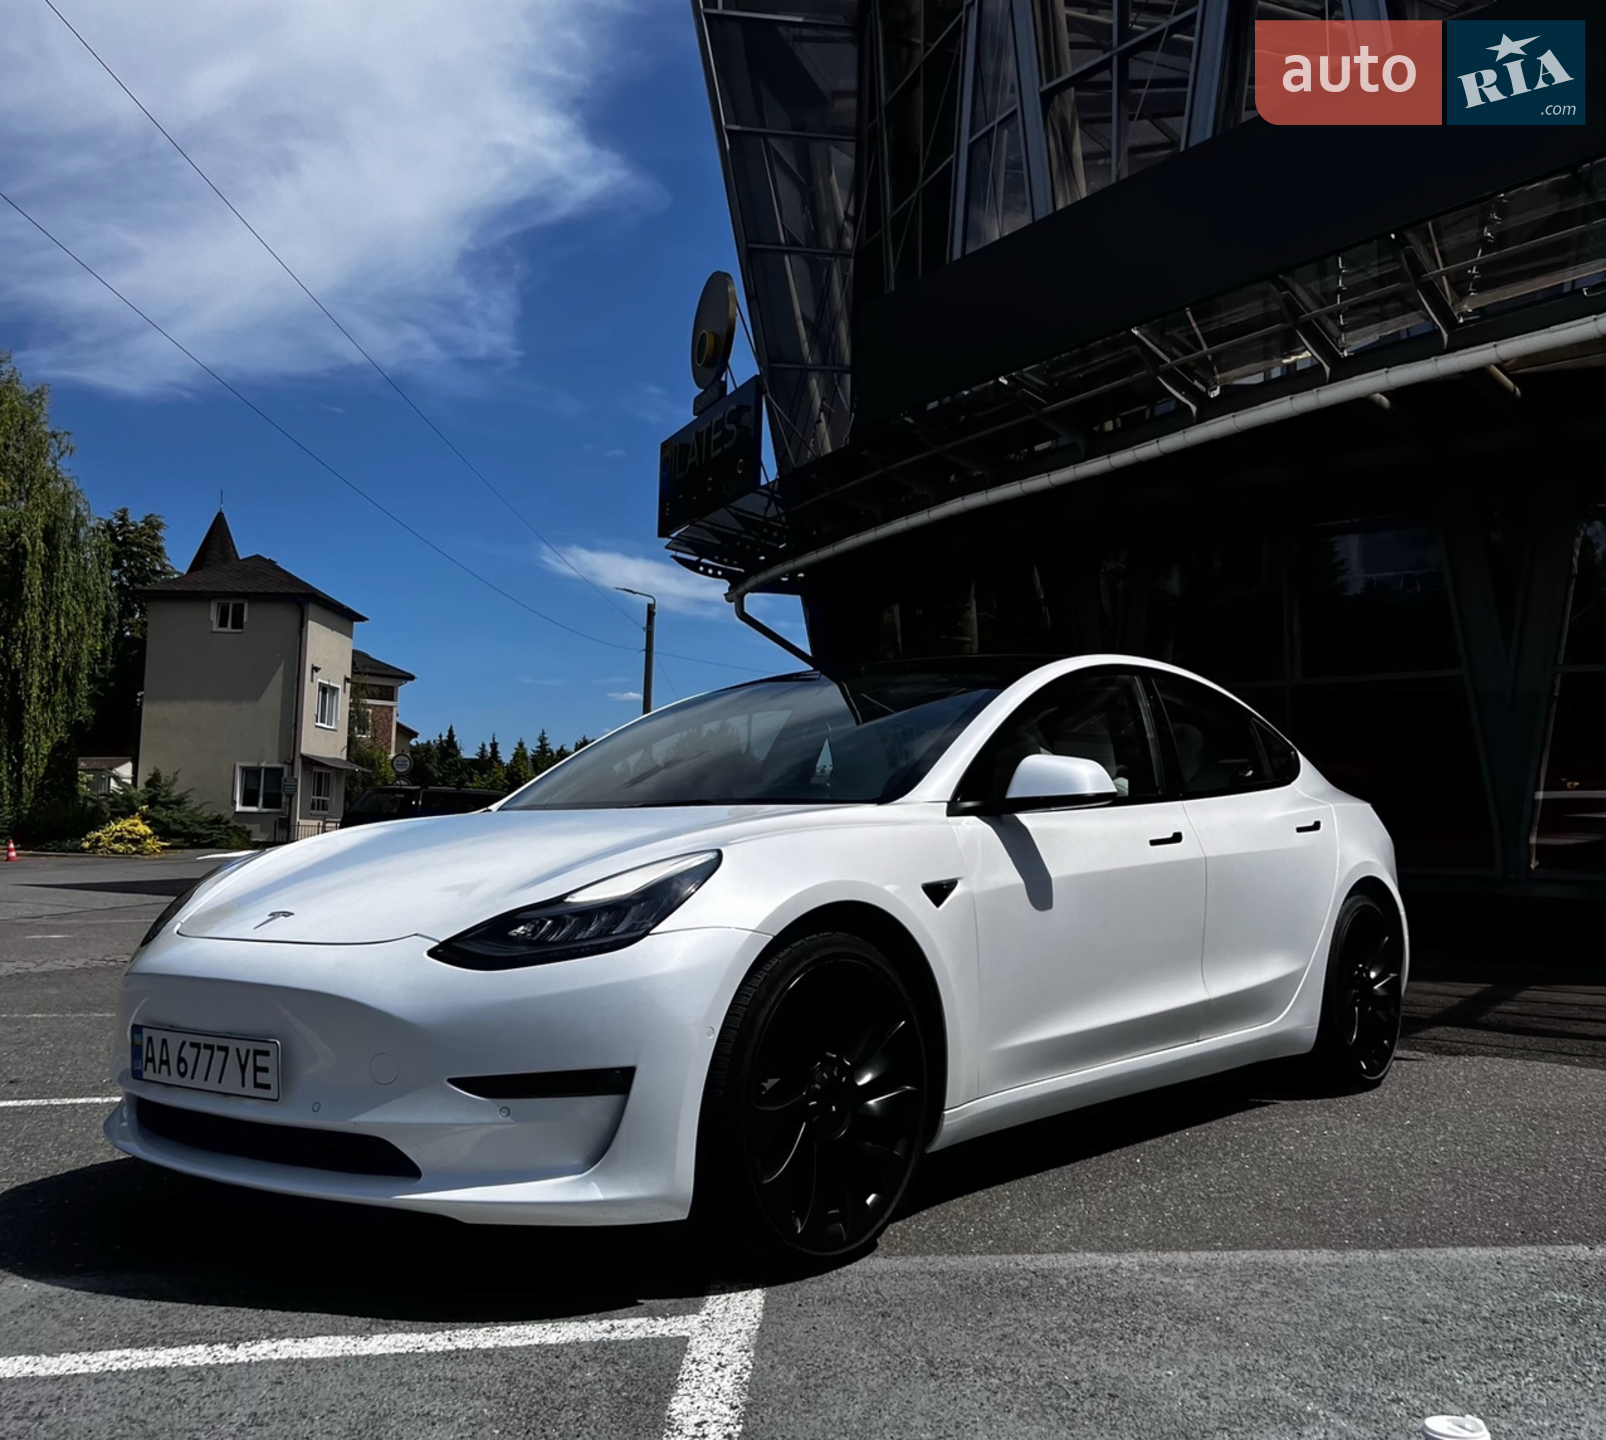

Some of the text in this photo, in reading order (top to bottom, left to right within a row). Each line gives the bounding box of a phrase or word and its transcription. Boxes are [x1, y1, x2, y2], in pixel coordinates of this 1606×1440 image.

[661, 403, 738, 484] PILATES
[144, 1036, 272, 1091] AA 6777 YE
